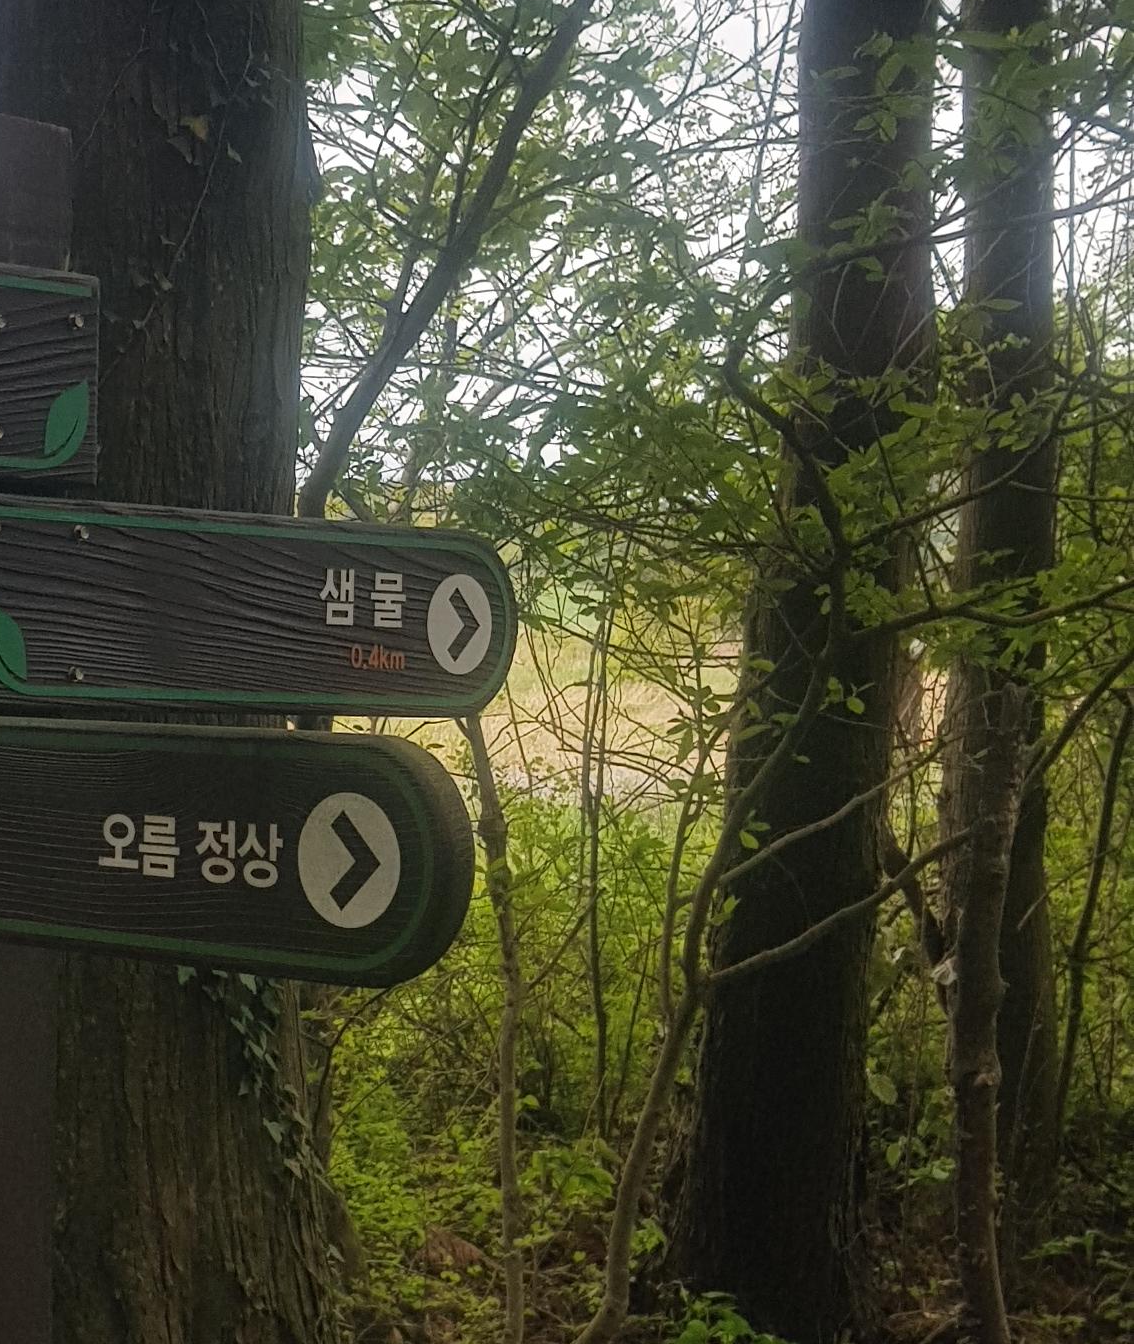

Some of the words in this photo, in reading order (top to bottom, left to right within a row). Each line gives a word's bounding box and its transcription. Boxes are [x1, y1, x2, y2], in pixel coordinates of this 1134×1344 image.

[350, 644, 405, 671] 0.4km
[98, 813, 180, 878] 오름
[196, 820, 284, 888] 정상
